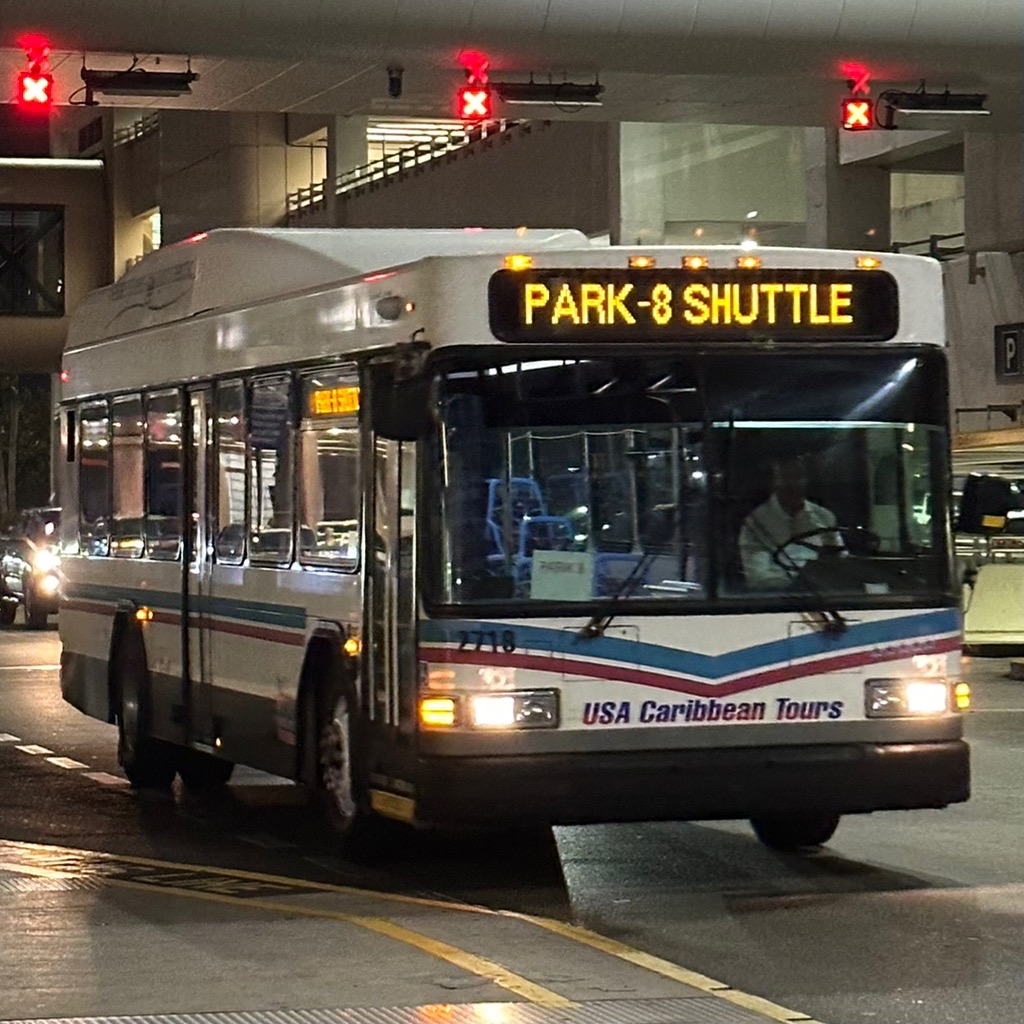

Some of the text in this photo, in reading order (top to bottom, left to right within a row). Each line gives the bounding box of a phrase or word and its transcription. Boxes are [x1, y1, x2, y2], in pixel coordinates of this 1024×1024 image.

[525, 283, 853, 324] PARK-8 SHUTTLE
[582, 698, 844, 725] USA Caribbean Tours
